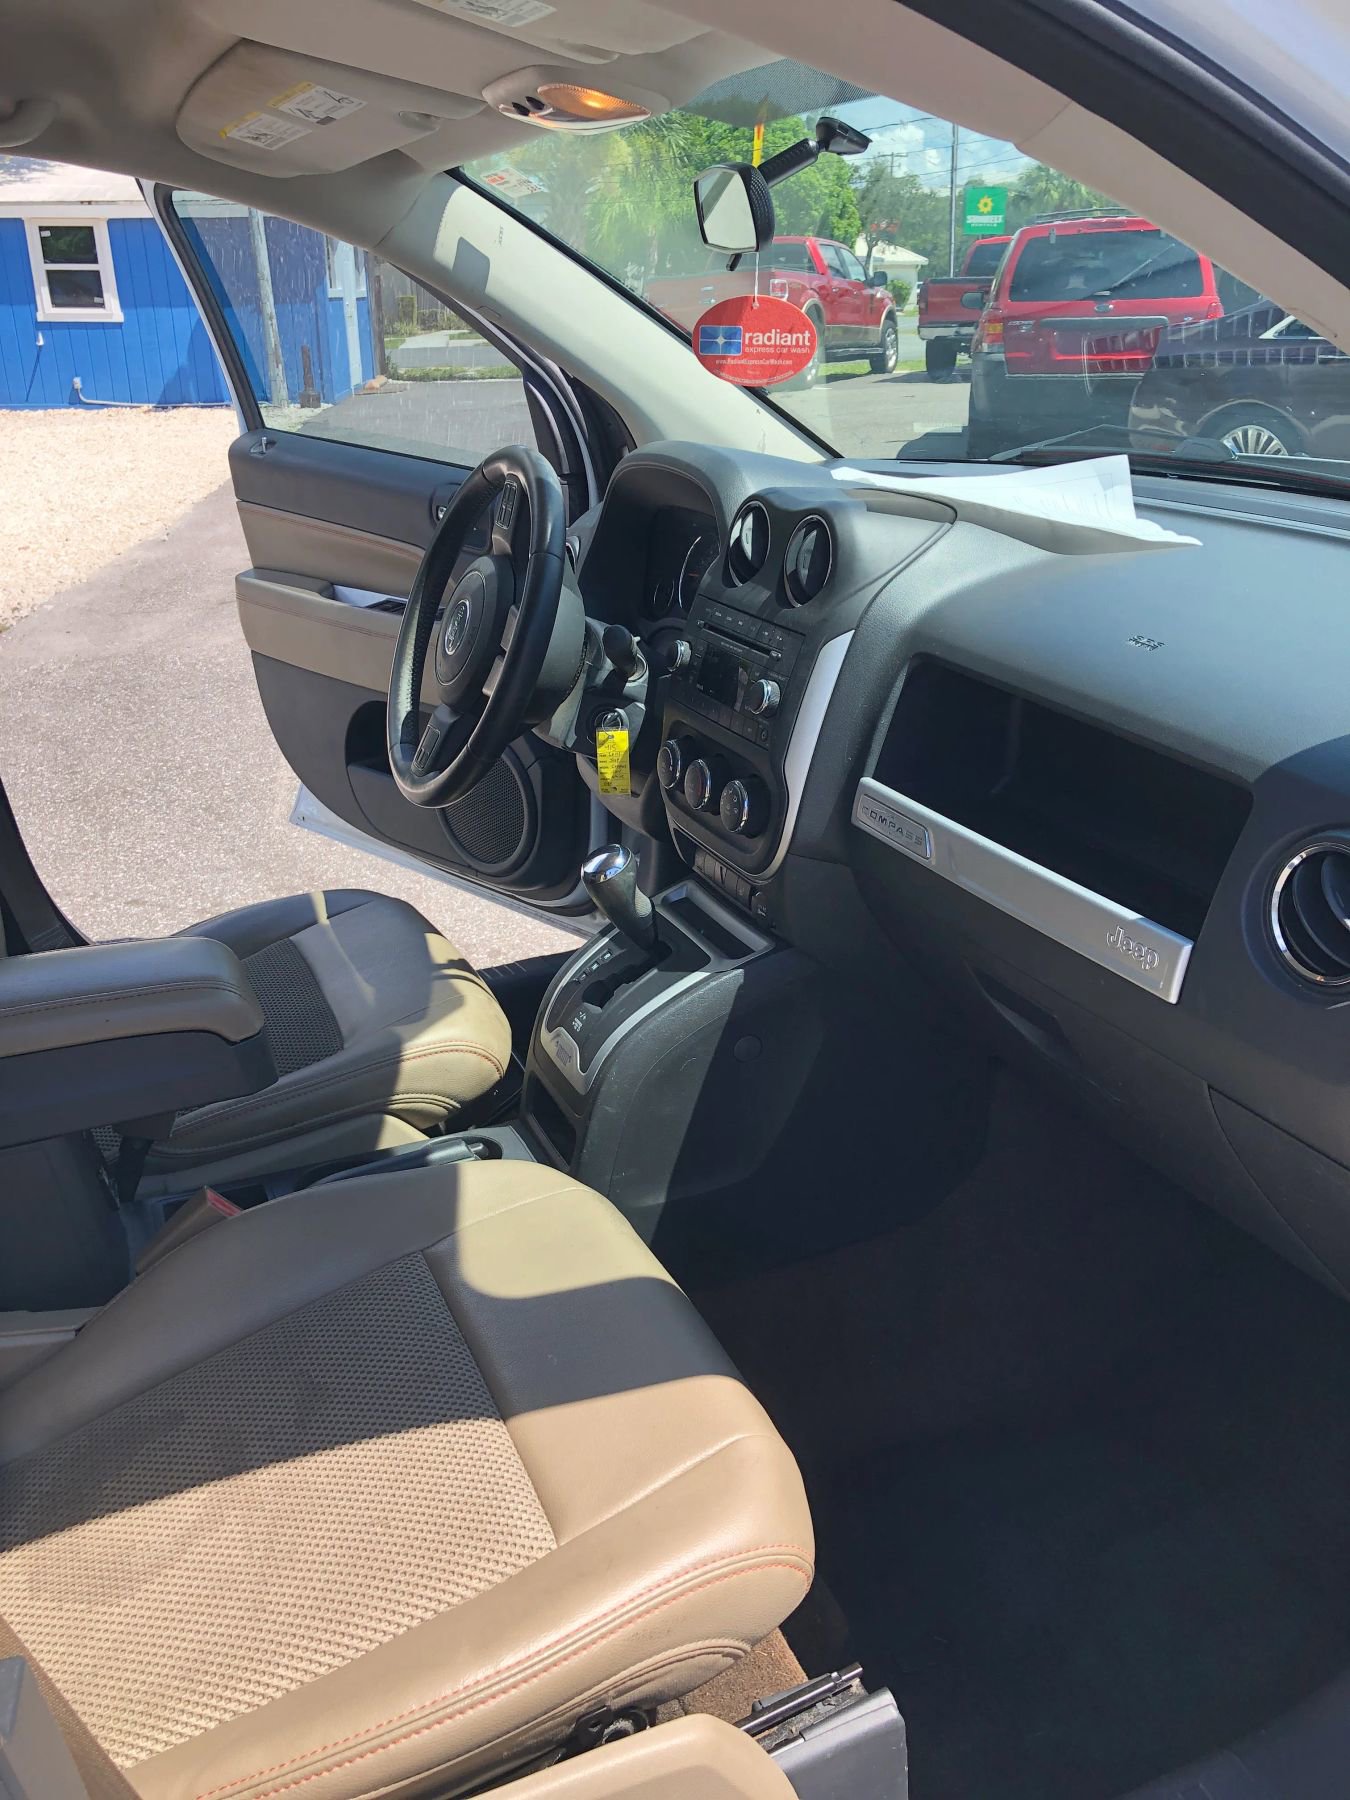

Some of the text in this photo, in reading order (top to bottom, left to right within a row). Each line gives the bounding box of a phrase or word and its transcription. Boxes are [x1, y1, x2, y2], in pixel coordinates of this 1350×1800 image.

[744, 328, 811, 346] radiant
[744, 346, 775, 354] express
[861, 805, 923, 846] COMPASS
[1106, 925, 1160, 970] Jeep
